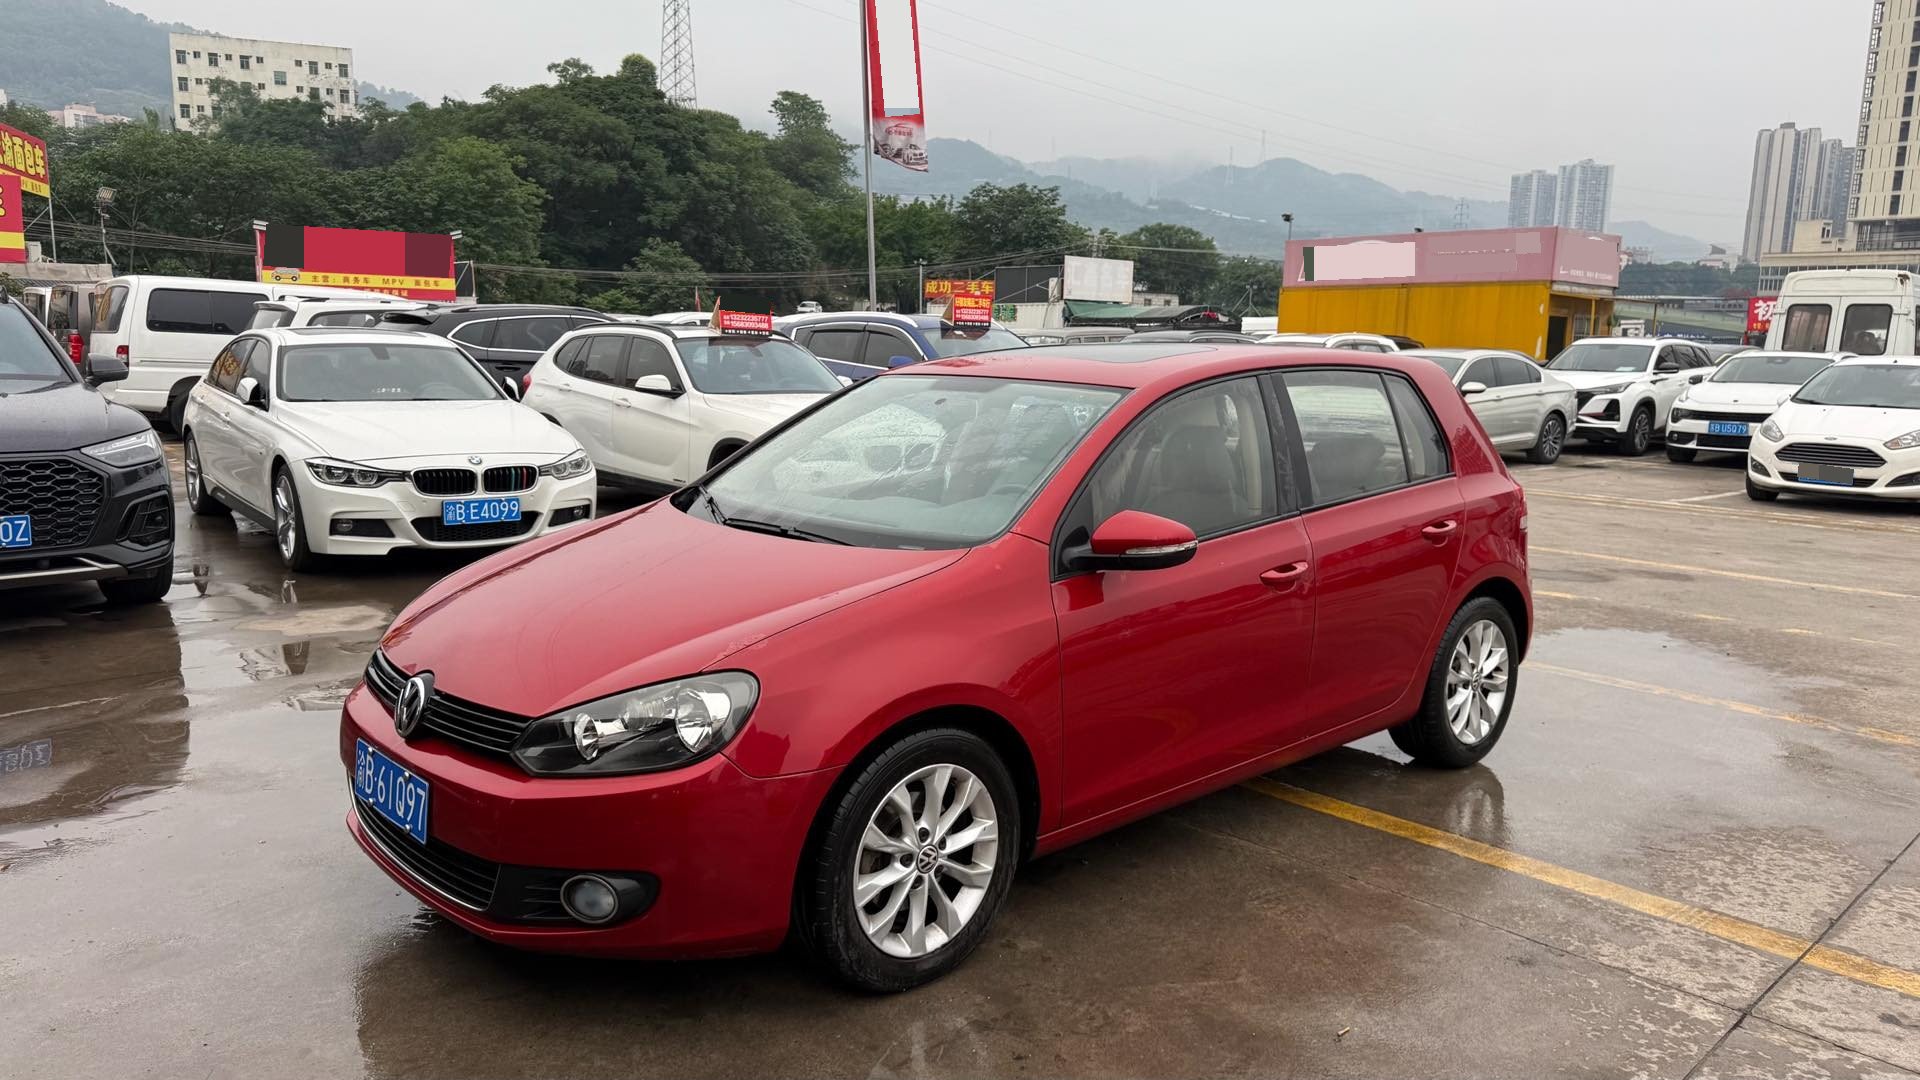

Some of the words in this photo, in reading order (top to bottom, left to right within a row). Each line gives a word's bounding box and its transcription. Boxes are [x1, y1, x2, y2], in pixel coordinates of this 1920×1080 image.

[382, 278, 405, 286] MPV
[925, 280, 994, 294] 成功二手车
